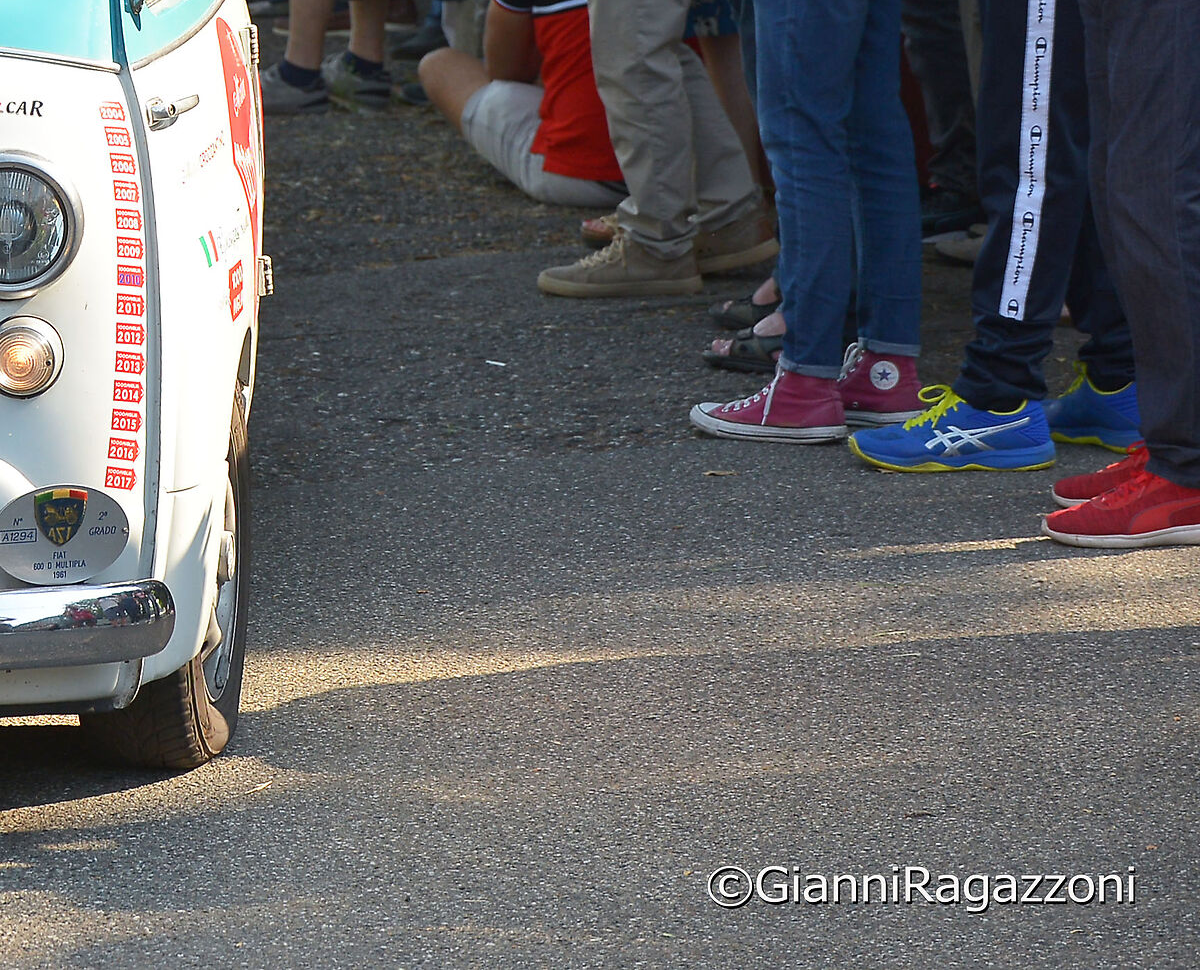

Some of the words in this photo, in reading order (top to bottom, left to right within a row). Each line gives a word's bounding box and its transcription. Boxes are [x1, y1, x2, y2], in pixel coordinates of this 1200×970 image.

[1032, 36, 1049, 112] Champion
[1026, 125, 1043, 199] Champion
[115, 188, 136, 201] 2007
[117, 217, 139, 230] 2008
[118, 245, 140, 258] 2009
[1012, 210, 1035, 286] Champion
[119, 273, 141, 285] 2010
[118, 301, 141, 315] 2011
[117, 331, 141, 343] 2012
[116, 360, 140, 373] 2013
[114, 388, 139, 401] 2014
[113, 417, 137, 430] 2015
[109, 446, 134, 460] 2016
[106, 475, 132, 489] 2017
[1, 531, 34, 542] A1294
[88, 525, 117, 536] GRADO
[53, 551, 67, 560] FIAT
[33, 562, 44, 570] 600
[55, 560, 86, 569] MULTIPLA
